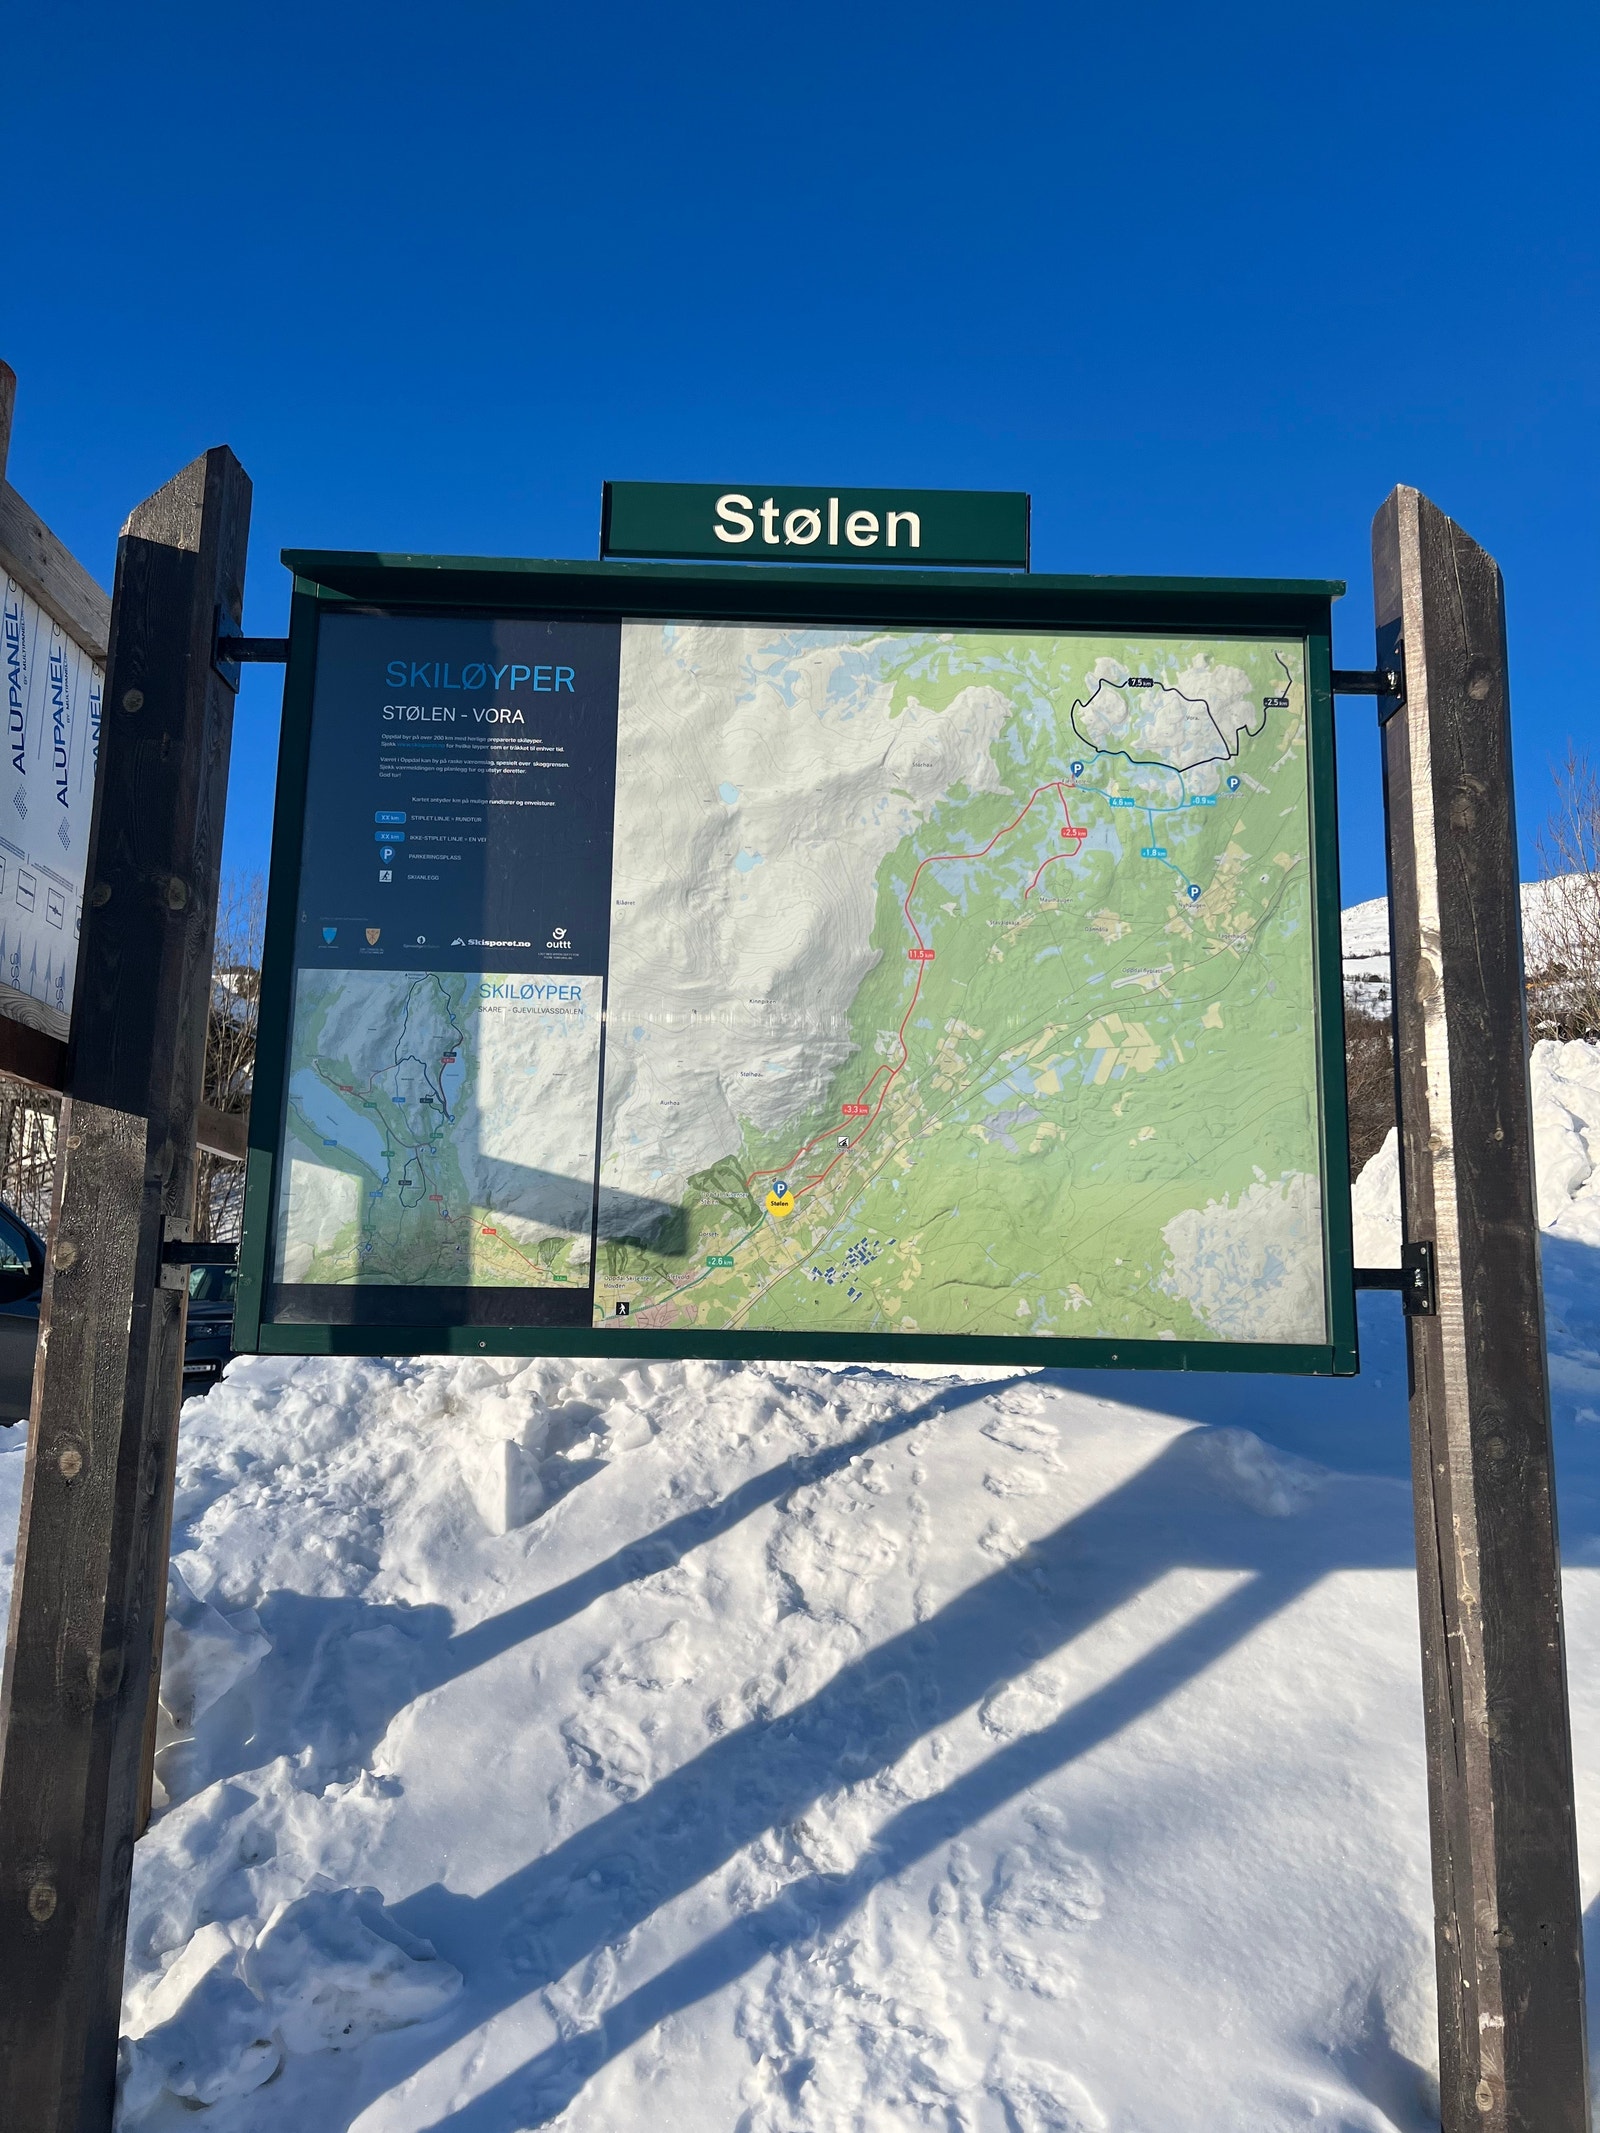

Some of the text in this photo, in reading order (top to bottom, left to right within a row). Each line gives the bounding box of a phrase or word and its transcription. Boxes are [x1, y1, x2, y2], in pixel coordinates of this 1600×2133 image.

[713, 493, 920, 548] Stølen
[4, 602, 26, 776] ALUPANEL
[385, 660, 576, 693] SKILØYPER
[50, 645, 69, 809] ALUPANEL
[382, 705, 456, 721] STØLEN
[472, 708, 525, 724] VORA
[546, 940, 572, 949] outtt
[479, 983, 582, 1001] SKILØYPER
